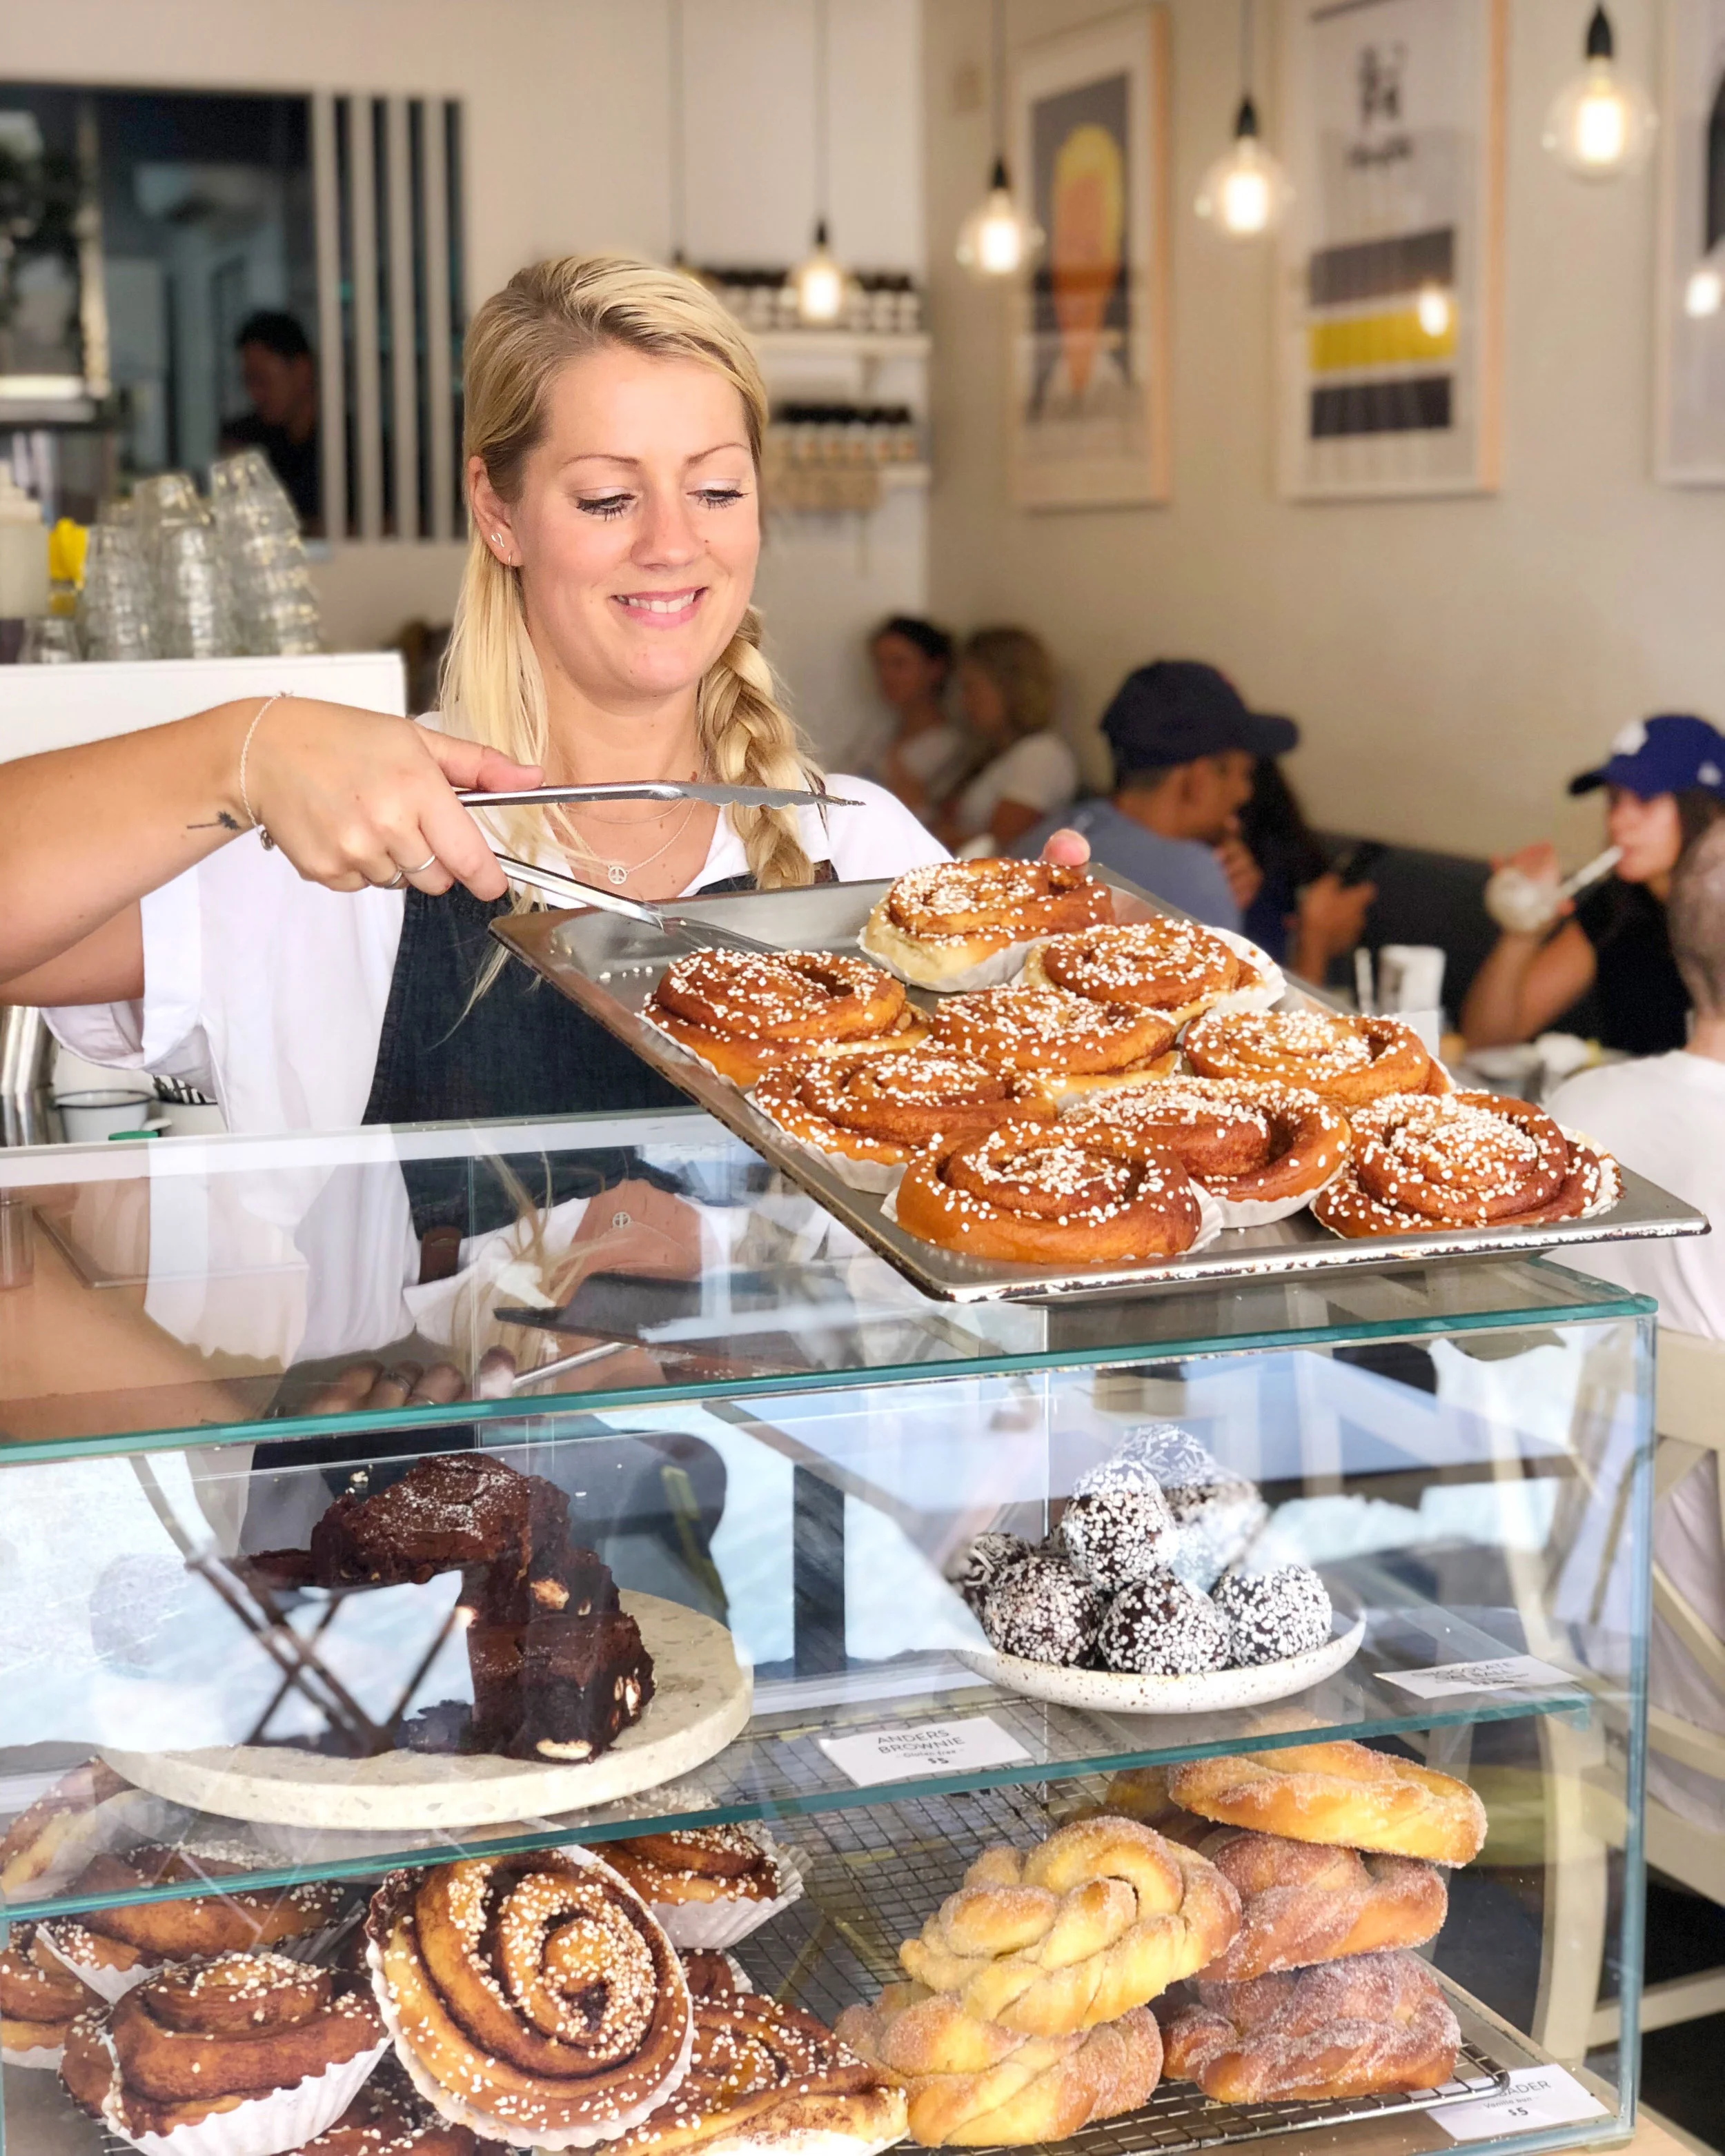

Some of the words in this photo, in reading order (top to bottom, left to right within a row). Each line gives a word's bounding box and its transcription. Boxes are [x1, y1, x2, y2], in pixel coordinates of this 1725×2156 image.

[878, 1729, 949, 1744] ANDERS
[878, 1737, 965, 1754] BROWNIE
[1483, 2099, 1515, 2108] Vanilla
[1508, 2106, 1529, 2116] $5
